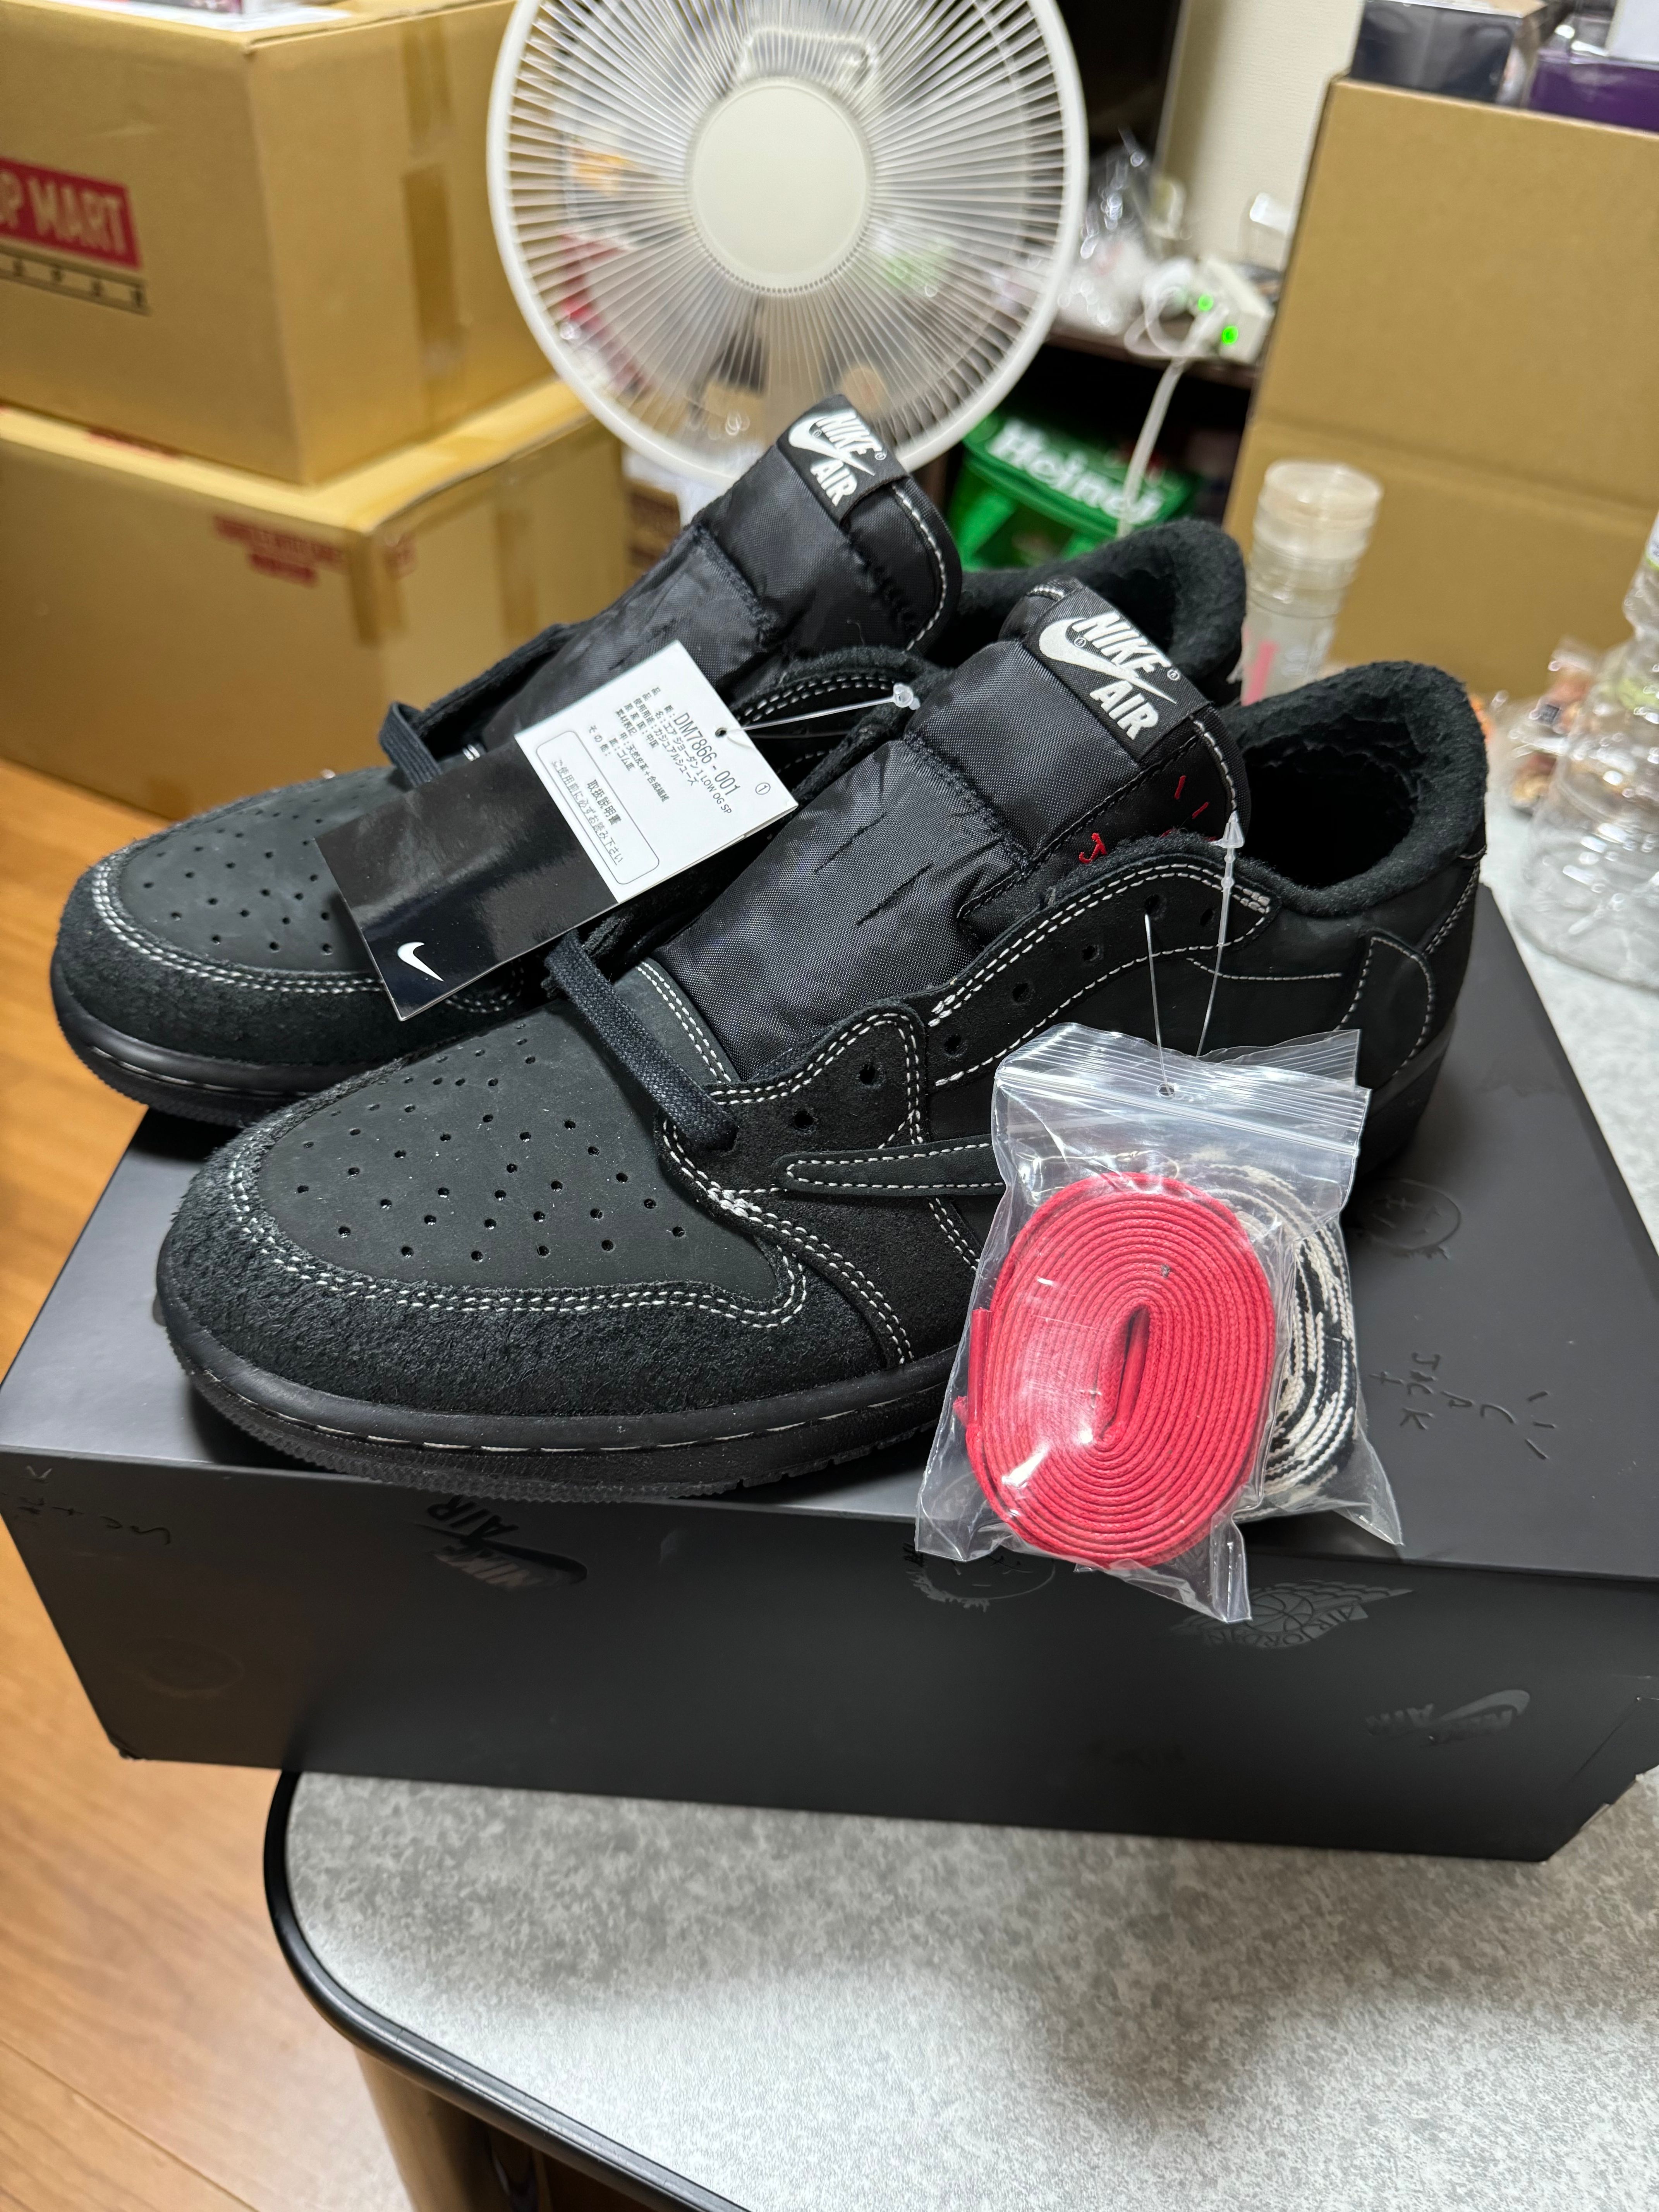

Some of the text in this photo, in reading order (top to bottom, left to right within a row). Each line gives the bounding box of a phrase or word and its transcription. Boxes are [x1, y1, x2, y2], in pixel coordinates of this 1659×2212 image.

[815, 409, 883, 455] NIKE
[810, 459, 857, 507] AIR
[1071, 611, 1172, 673] NIKE
[1089, 680, 1159, 740] AIR
[553, 758, 625, 864] ご使用前に必ずお読み下さい
[586, 778, 622, 826] 取扱説明書
[699, 775, 717, 793] LOW
[712, 792, 725, 805] OG
[720, 803, 732, 815] SP
[427, 1495, 519, 1539] AIR
